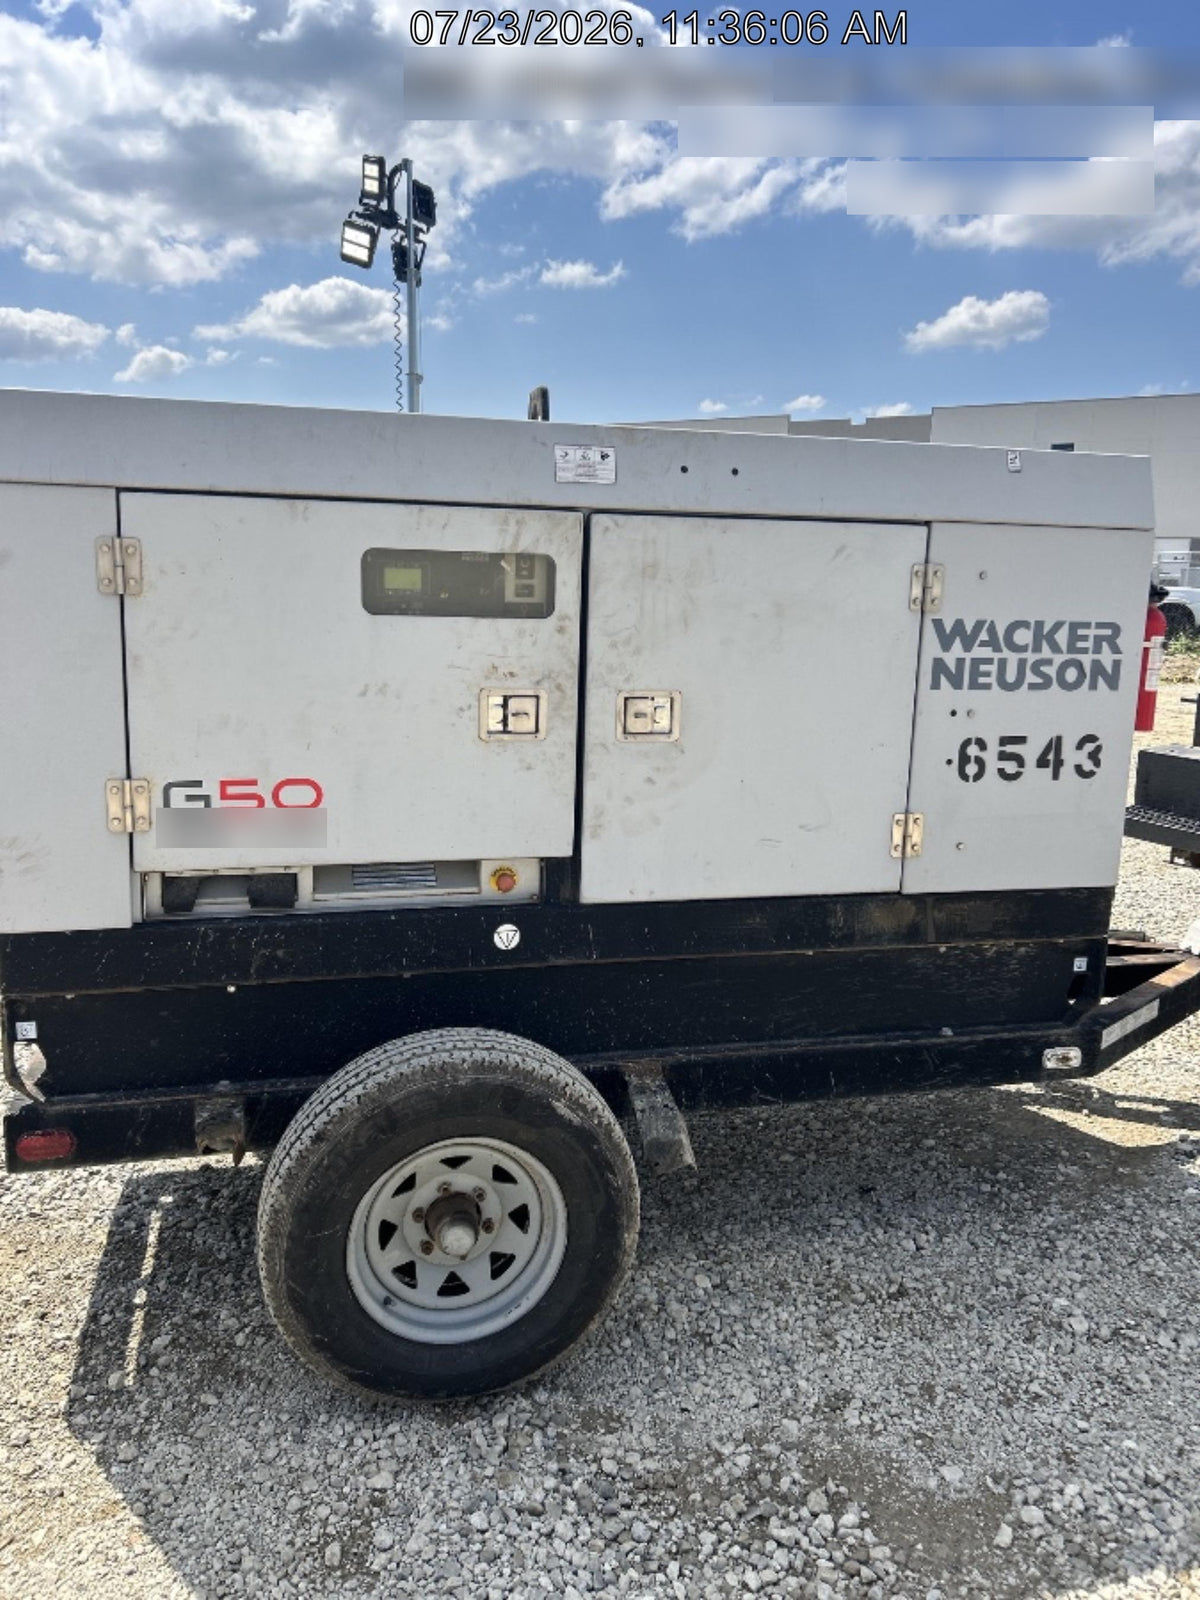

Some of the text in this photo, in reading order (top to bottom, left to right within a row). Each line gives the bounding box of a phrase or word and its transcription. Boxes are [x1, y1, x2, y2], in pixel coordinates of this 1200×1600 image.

[931, 618, 1123, 655] WACKER
[929, 657, 1122, 692] NEUSON
[957, 734, 1103, 783] 6543
[162, 777, 324, 809] G50
